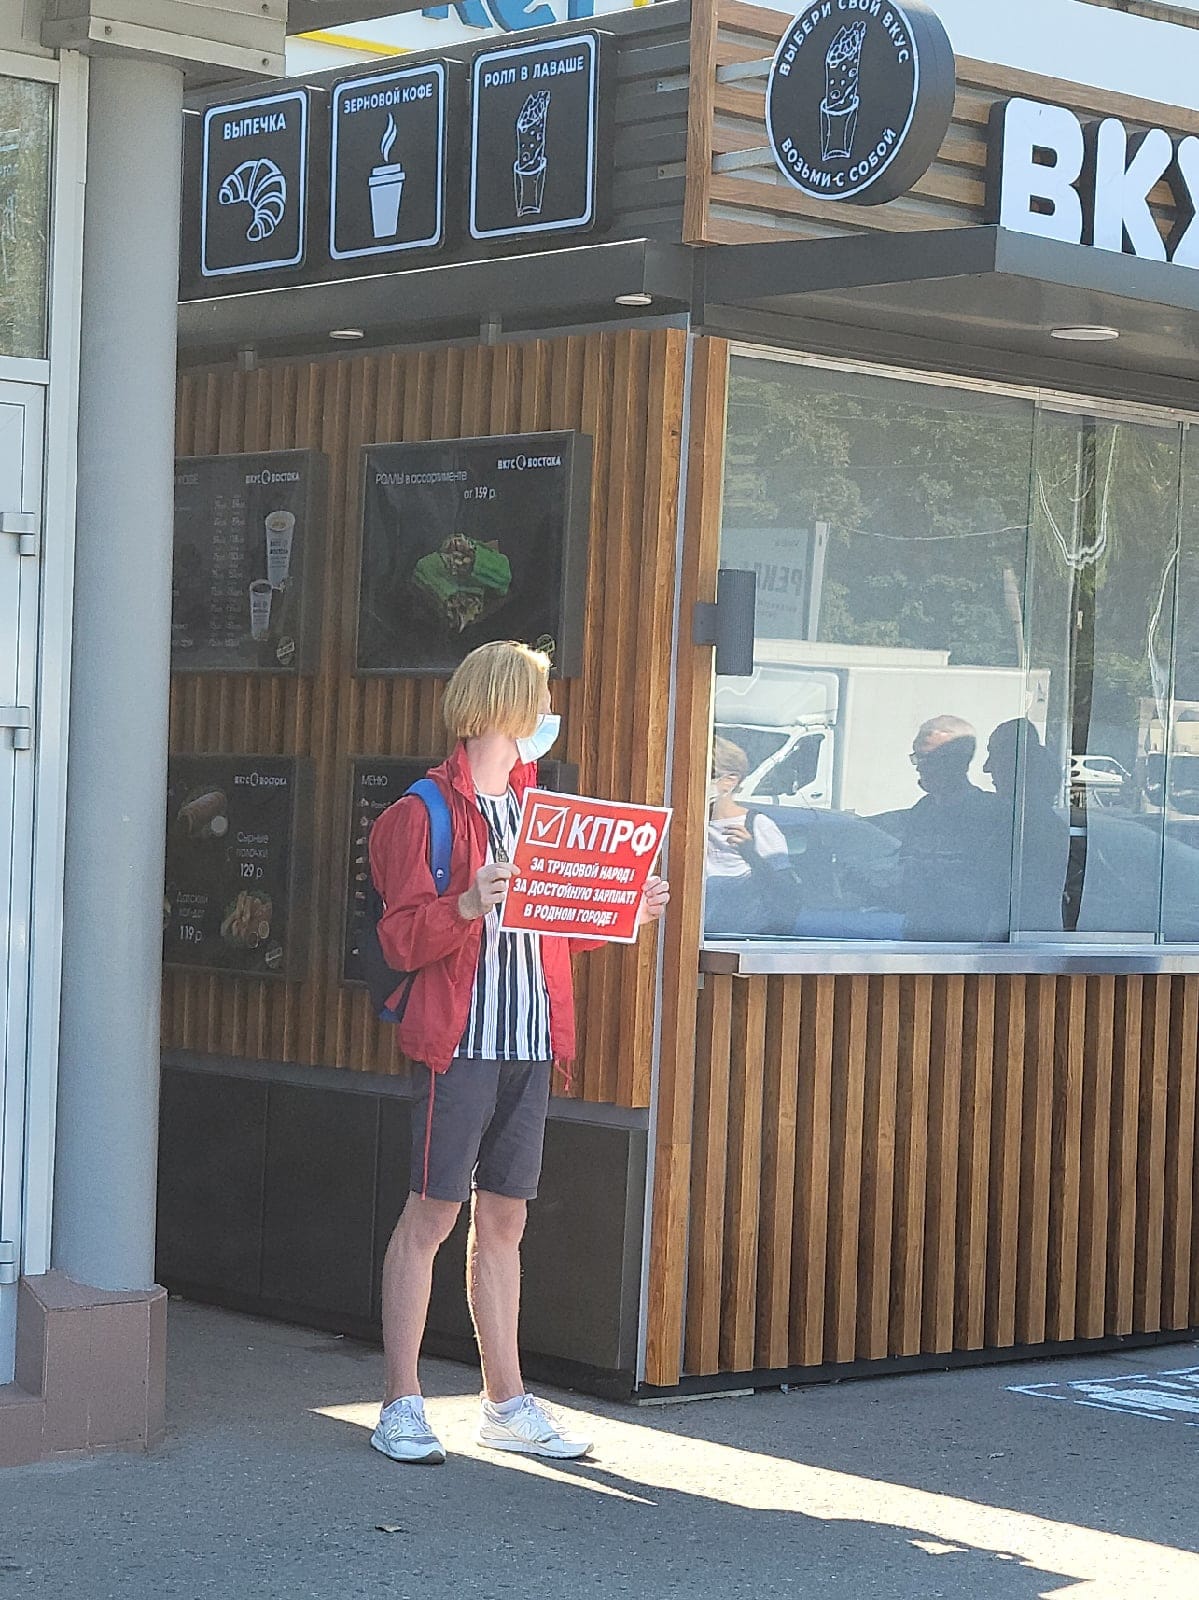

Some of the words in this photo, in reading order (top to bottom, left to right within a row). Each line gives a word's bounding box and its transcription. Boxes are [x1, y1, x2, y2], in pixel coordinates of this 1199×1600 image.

[779, 2, 831, 77] ВЫБЕРИ
[838, 0, 881, 18] СВОЙ
[882, 13, 910, 64] ВКУС
[484, 68, 515, 88] РОЛЛ
[520, 65, 529, 82] В
[532, 55, 585, 80] ЛАВАШЕ
[343, 87, 400, 114] ЗЕРНОВОЙ
[402, 82, 433, 105] КОФЕ
[223, 112, 287, 141] ВЫПЕЧКА
[781, 137, 831, 187] ВОЗЬМИ
[849, 128, 897, 182] СОБОЙ
[475, 487, 488, 499] 159
[566, 813, 658, 857] КПРФ
[240, 863, 254, 878] 129
[530, 857, 545, 872] ЗА
[547, 859, 600, 879] ТРУДОВОЙ
[513, 877, 528, 893] ЗА
[527, 880, 592, 901] ДОСТОЙНУЮ
[523, 903, 533, 918] В
[533, 904, 575, 922] РОДНОМ
[179, 925, 194, 940] 119
